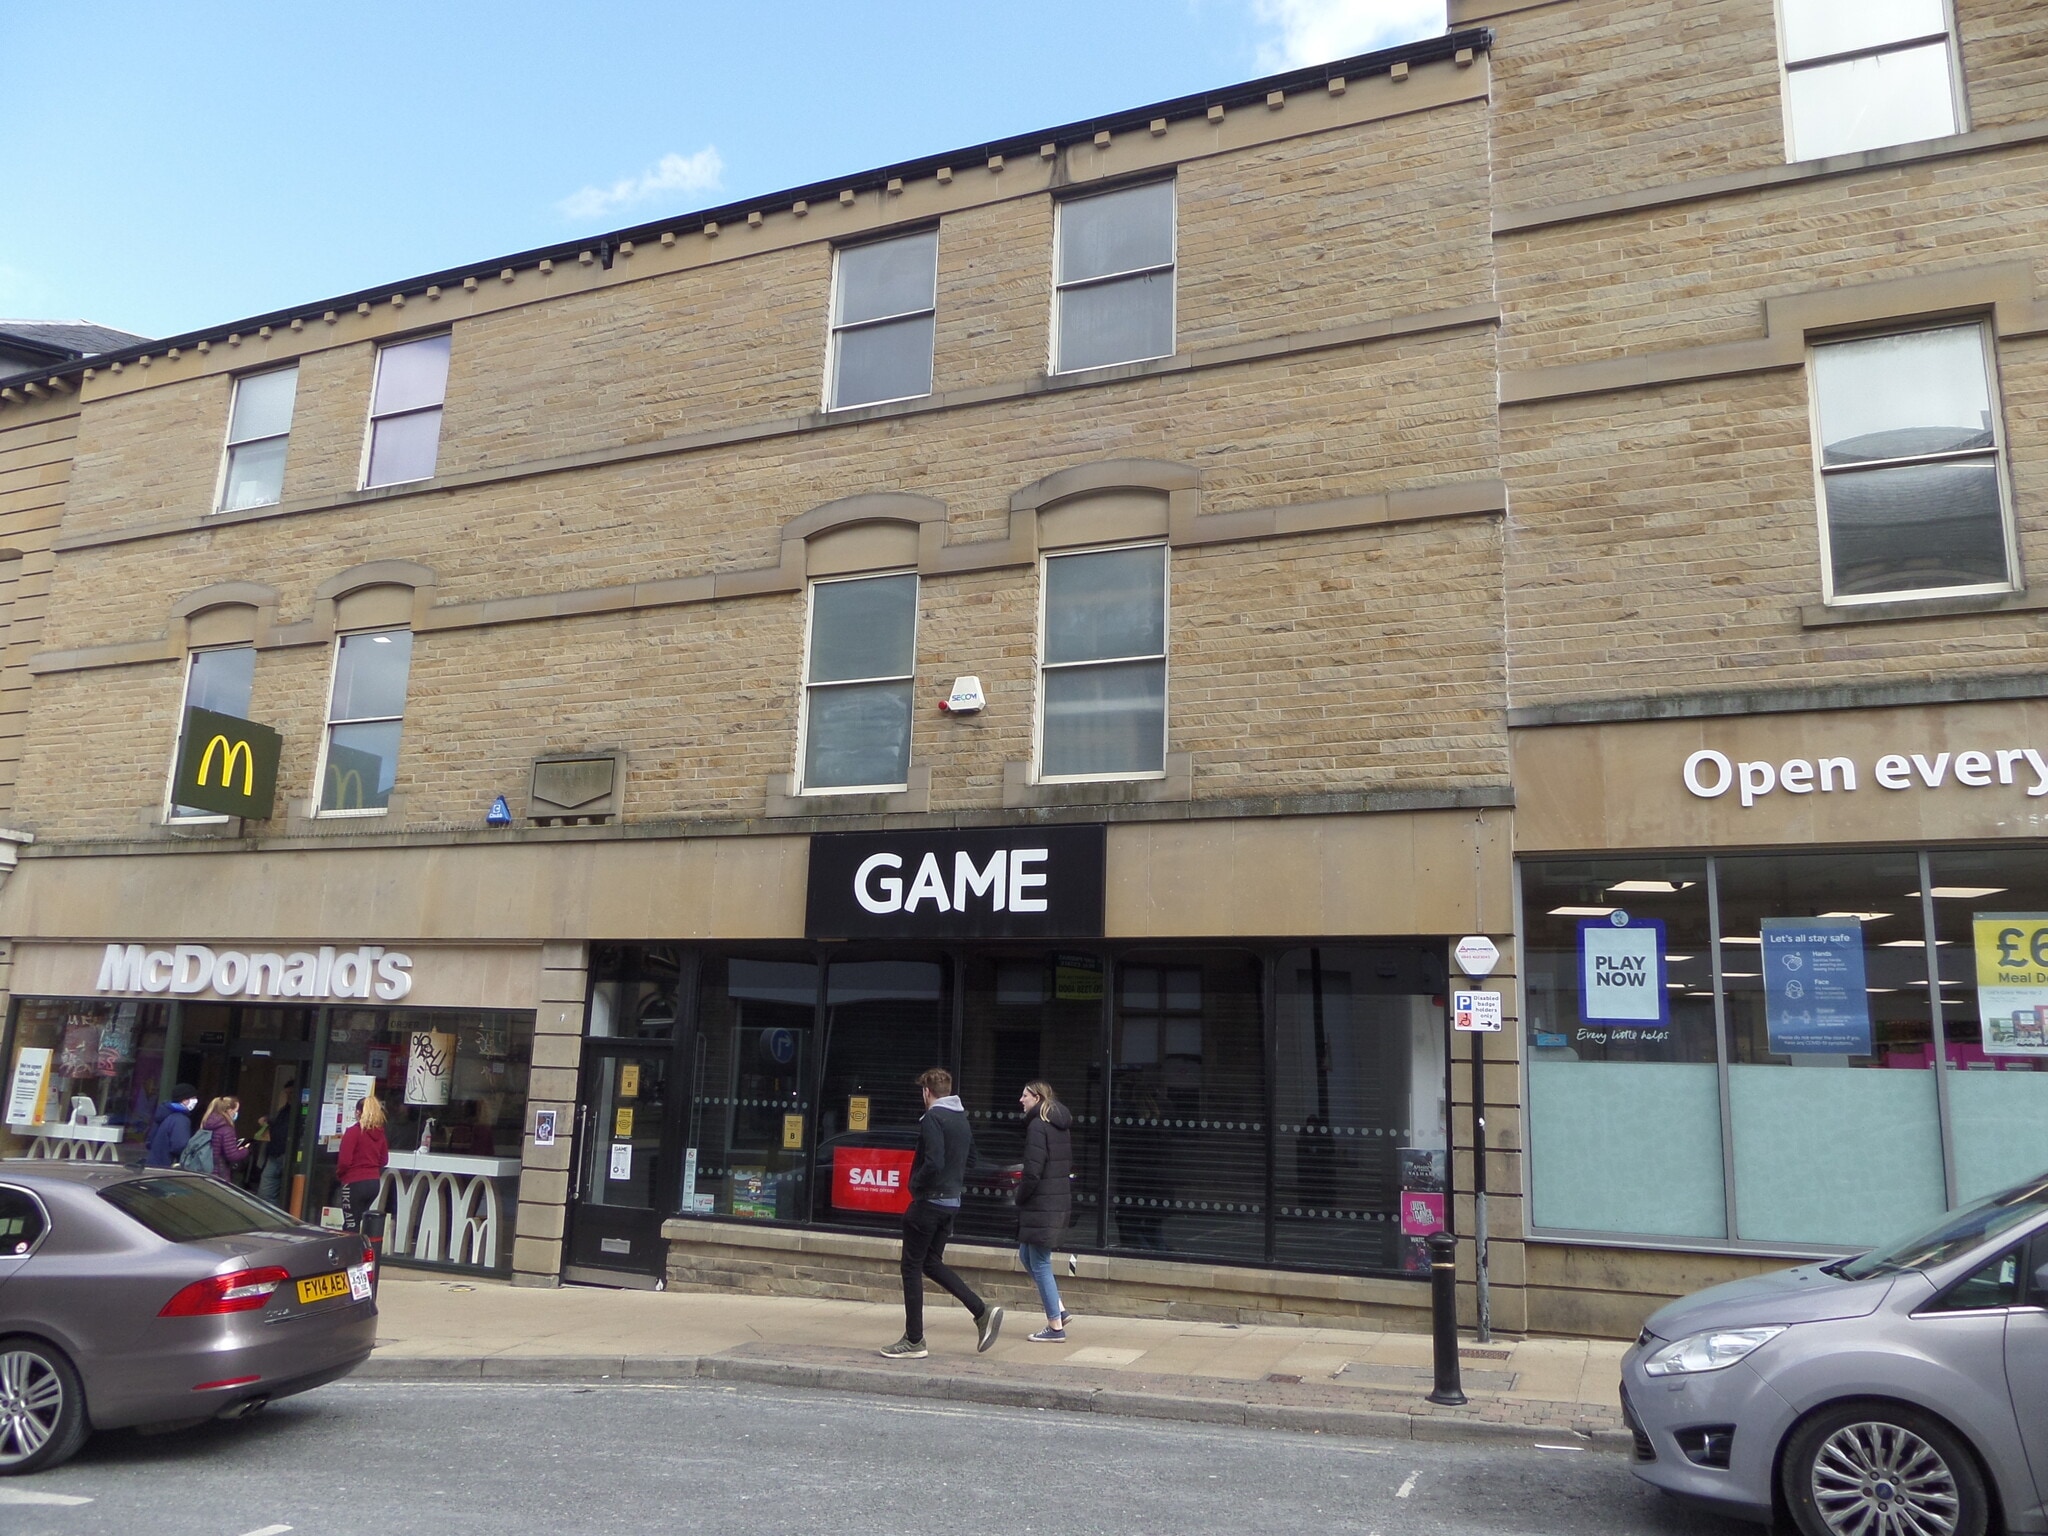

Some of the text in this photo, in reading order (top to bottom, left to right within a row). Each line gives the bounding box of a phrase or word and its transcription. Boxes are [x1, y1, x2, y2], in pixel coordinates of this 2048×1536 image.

[952, 693, 977, 702] SECOM
[1682, 748, 2048, 808] Open every
[853, 848, 1050, 915] GAME
[1770, 934, 1850, 944] Let's all stay safe
[1595, 956, 1646, 970] PLAY
[96, 943, 413, 1001] McDonald's
[1596, 972, 1646, 987] NOW
[1998, 972, 2032, 983] Meal
[1460, 996, 1470, 1009] P
[1576, 1028, 1670, 1044] Every little helps
[848, 1167, 900, 1187] SALE
[342, 1183, 356, 1228] NIKE AIR
[304, 1274, 348, 1299] FY14 AEX
